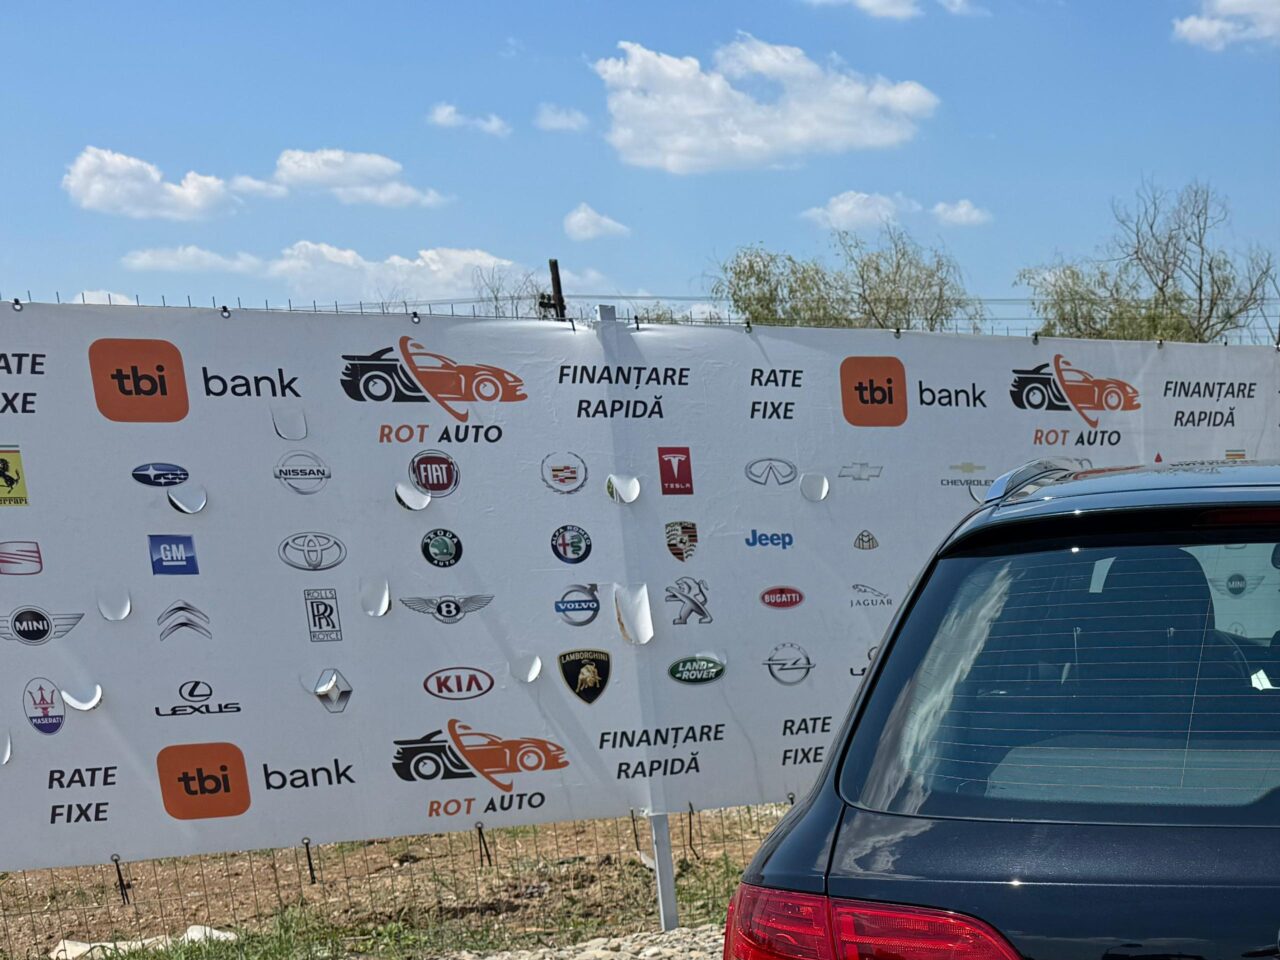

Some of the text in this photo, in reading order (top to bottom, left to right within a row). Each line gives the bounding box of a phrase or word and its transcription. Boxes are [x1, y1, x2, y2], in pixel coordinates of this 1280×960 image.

[111, 365, 302, 398] tbi bank
[558, 365, 691, 391] FINANȚARE
[750, 368, 803, 388] RATE
[854, 376, 987, 409] tbi bank
[1163, 380, 1258, 404] FINANȚARE
[577, 395, 664, 419] RAPIDĂ
[750, 401, 795, 420] FIXE
[1174, 406, 1235, 428] RAPIDĂ
[379, 425, 503, 444] ROT AUTO
[1033, 429, 1122, 446] ROT AUTO
[278, 468, 326, 477] NISSAN
[420, 463, 448, 484] FIAT
[567, 525, 591, 546] ROMEO
[744, 529, 793, 550] Jeep
[160, 543, 186, 561] GM
[558, 601, 598, 610] VOLVO
[764, 593, 800, 604] BUGATTI
[850, 598, 893, 608] JAGUAR
[16, 619, 49, 632] MINI
[560, 652, 609, 663] LAMBORGHINI
[678, 661, 708, 672] LAND
[435, 674, 487, 693] KIA
[681, 669, 717, 680] ROVER
[155, 702, 242, 717] LEXUS
[32, 716, 63, 725] MASERATI
[782, 716, 832, 737] RATE
[599, 723, 725, 751] FINANȚARE
[616, 750, 700, 780] RAPIDĂ
[782, 746, 824, 766] FIXE
[48, 766, 117, 789] RATE
[177, 759, 355, 796] tbi bank
[50, 802, 109, 824] FIXE
[428, 792, 545, 818] ROT AUTO
